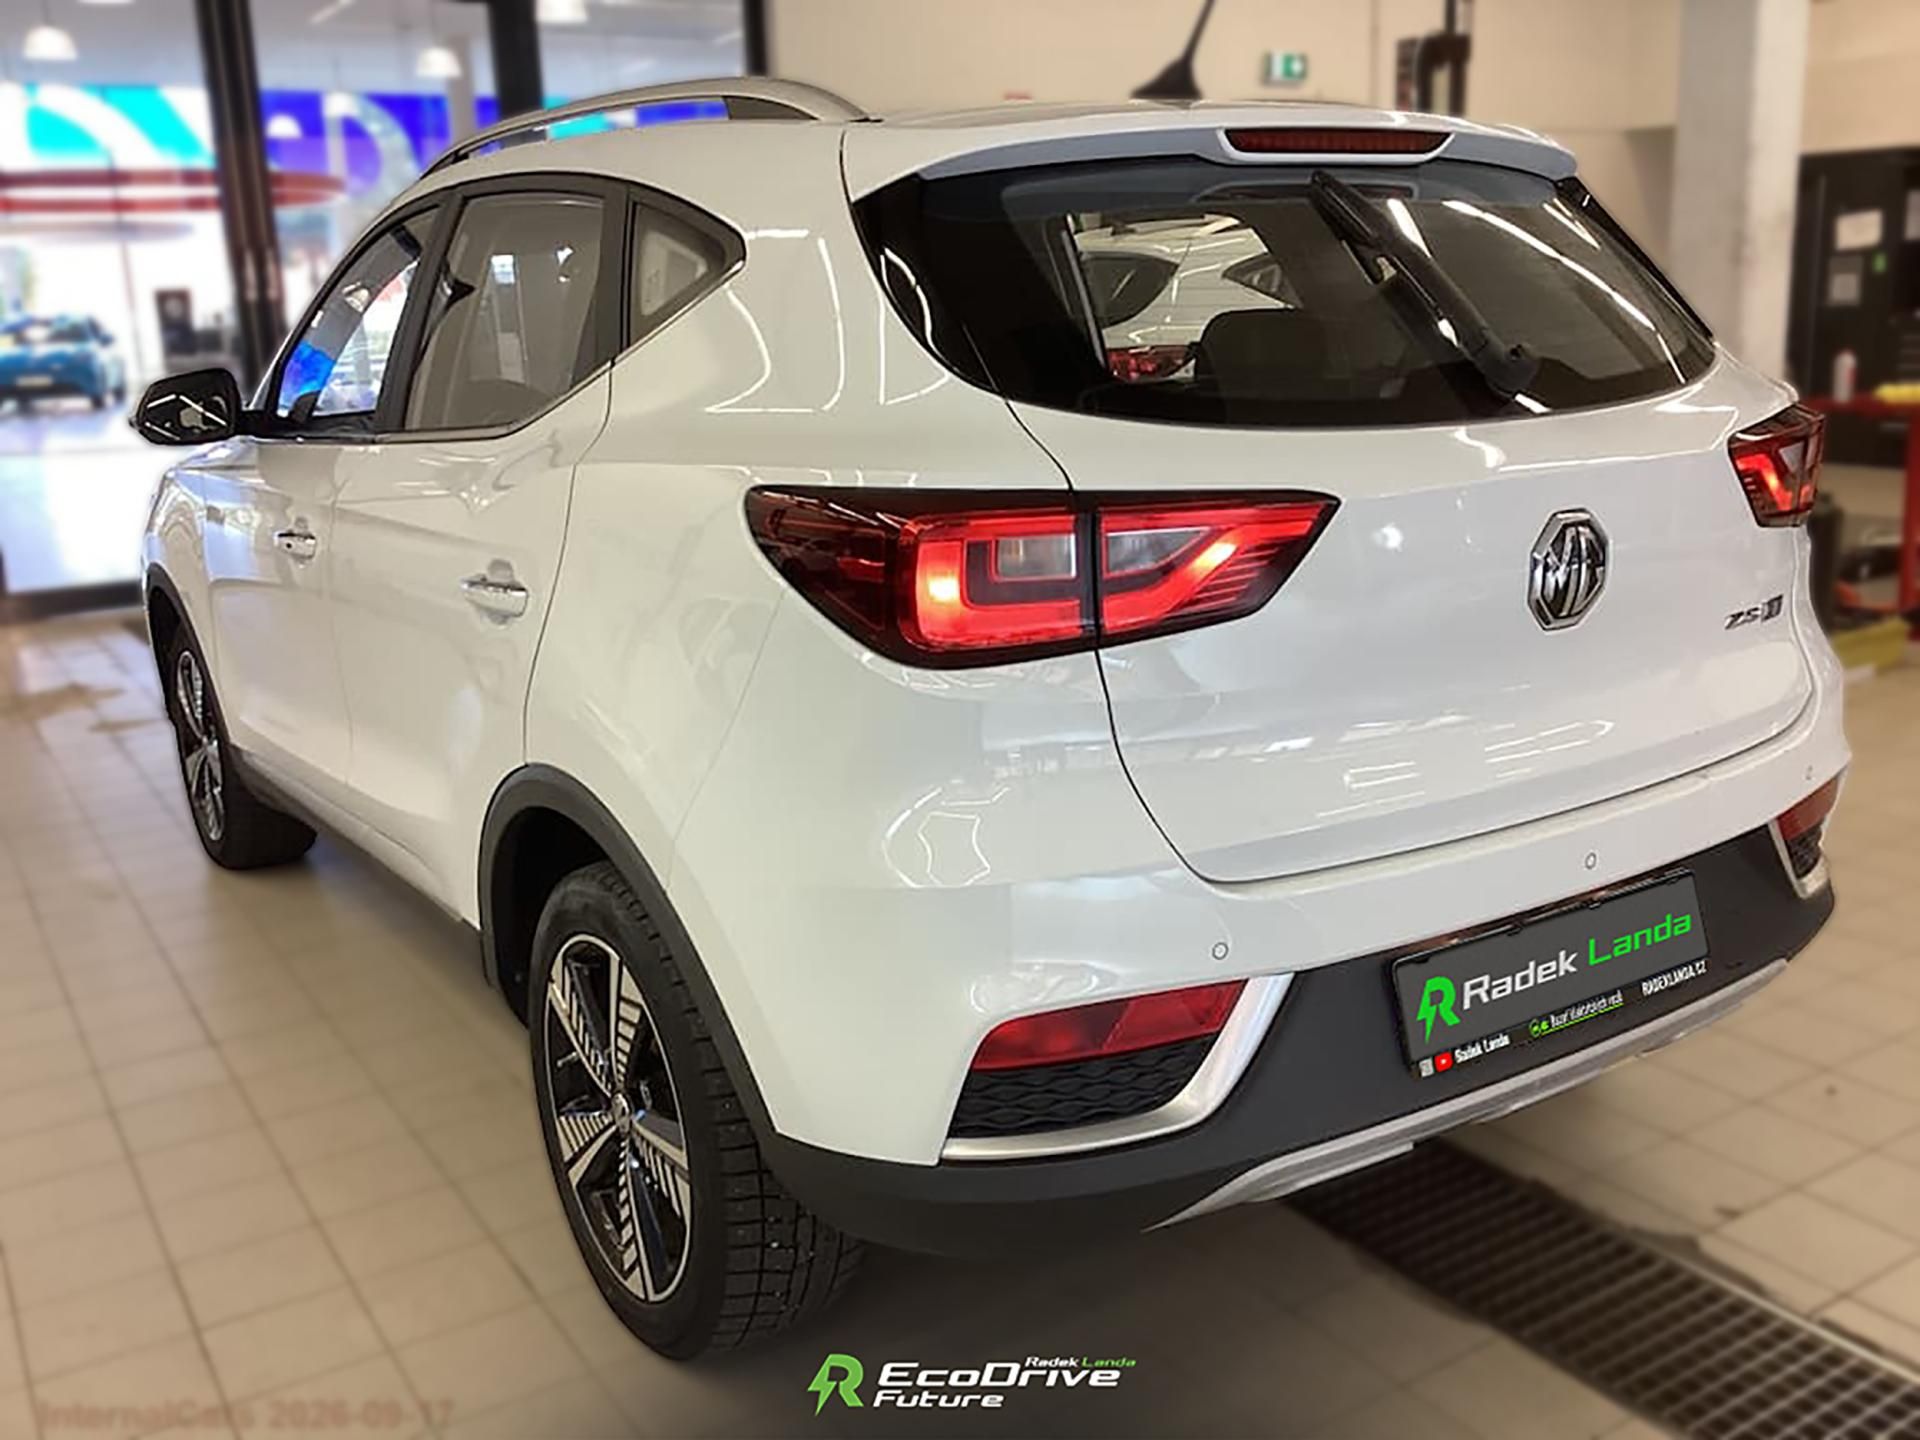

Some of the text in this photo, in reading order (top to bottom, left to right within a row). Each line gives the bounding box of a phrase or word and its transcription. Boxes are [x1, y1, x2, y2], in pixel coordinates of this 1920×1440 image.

[1532, 522, 1605, 619] MG
[1462, 913, 1692, 1010] Radek Landa
